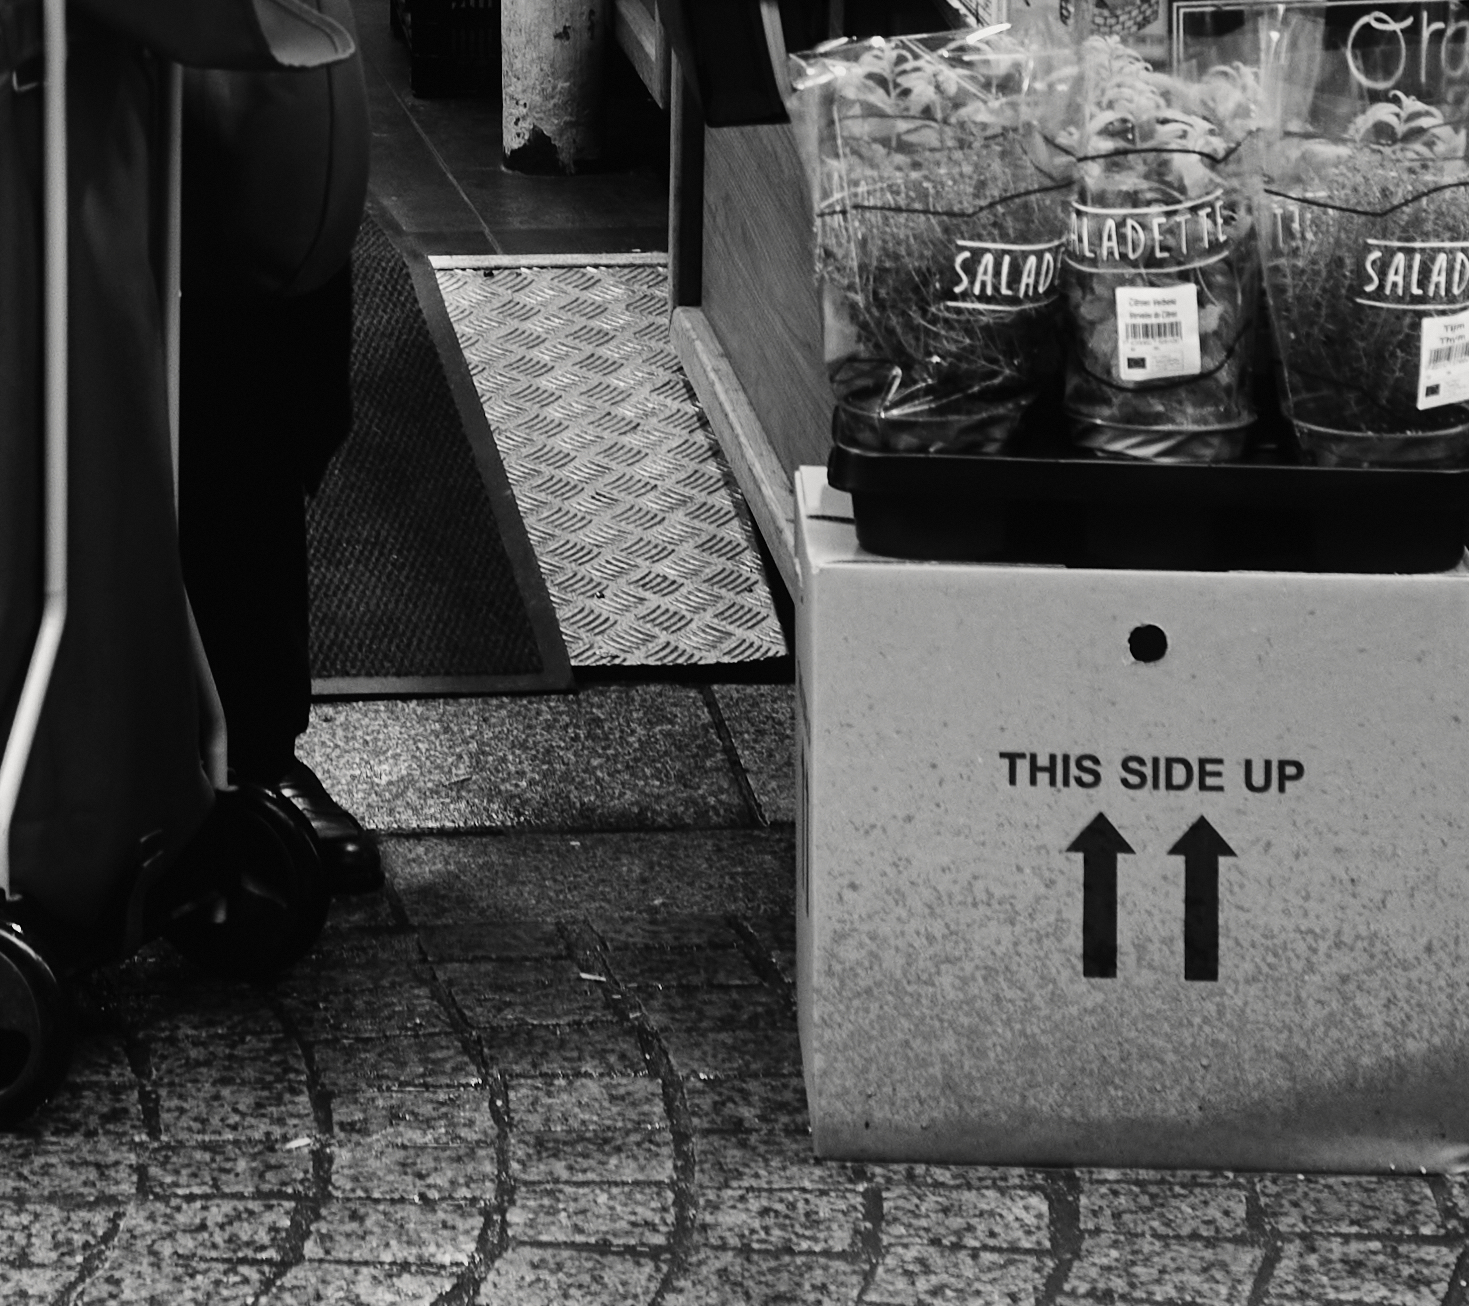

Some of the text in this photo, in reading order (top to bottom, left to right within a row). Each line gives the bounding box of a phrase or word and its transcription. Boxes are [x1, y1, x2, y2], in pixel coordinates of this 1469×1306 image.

[1067, 200, 1230, 263] ALADETTE
[953, 249, 1061, 297] SALAD
[998, 750, 1306, 795] THIS SIDE UP
